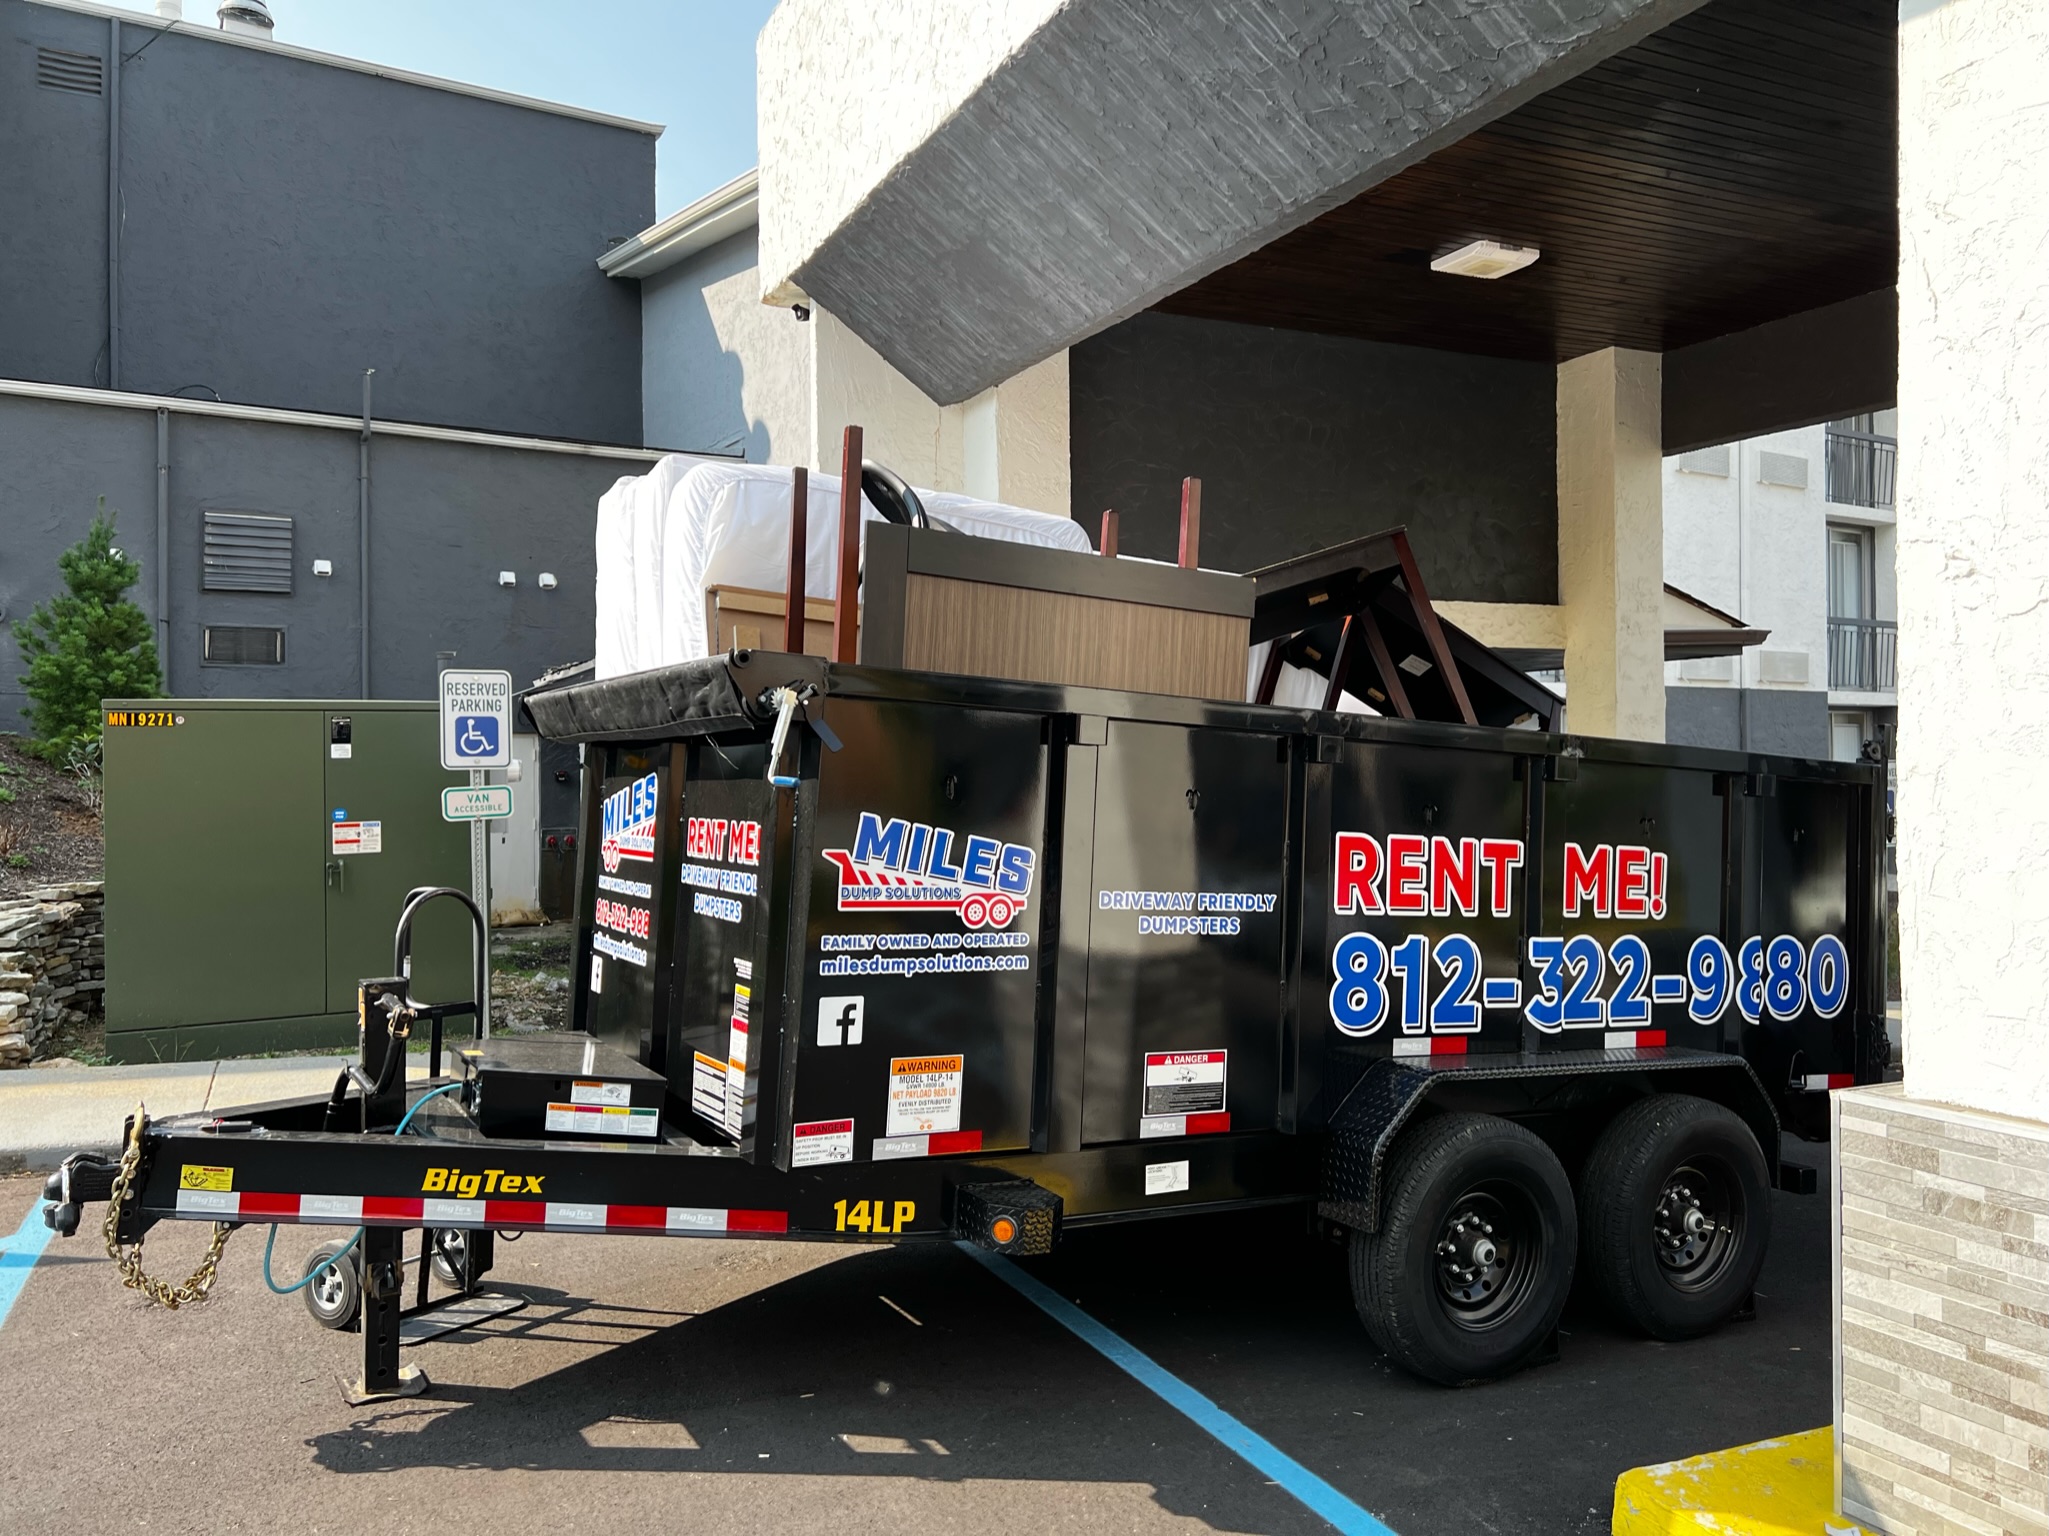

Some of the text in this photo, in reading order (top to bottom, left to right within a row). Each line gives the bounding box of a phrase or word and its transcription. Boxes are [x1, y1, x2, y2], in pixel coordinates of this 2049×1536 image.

[447, 683, 506, 696] RESERVED
[451, 699, 502, 712] PARKING
[467, 794, 489, 803] VAN
[454, 804, 503, 813] ACCESSIBLE
[603, 772, 658, 842] MILES
[687, 817, 762, 866] RENT ME!
[852, 811, 1036, 895] MILES
[681, 863, 720, 889] DRIVEWAY
[1333, 831, 1669, 921] RENT ME!
[841, 887, 961, 900] DUMP SOLUTIONS
[693, 892, 742, 923] DUMPSTERS
[1099, 891, 1277, 912] DRIVEWAY FRIENDLY
[1138, 915, 1240, 935] DUMPSTERS
[821, 932, 1029, 950] FAMILY OWNED AND OPERATED
[819, 953, 1029, 977] milesdumpsolutions.com
[1174, 1054, 1209, 1064] DANGER
[907, 1060, 956, 1071] WARNING
[899, 1073, 953, 1084] MODEL 14LP-14
[892, 1090, 904, 1100] NET
[905, 1088, 932, 1099] PAYLOAD
[898, 1098, 952, 1108] EVENLY DISTRIBUTED
[810, 1123, 846, 1133] DANGER
[1150, 1122, 1177, 1131] BigTex
[885, 1142, 917, 1152] BigTex
[421, 1167, 546, 1199] BigTex
[190, 1195, 225, 1206] BigTex
[313, 1200, 349, 1211] BigTex
[437, 1204, 472, 1214] BigTex
[558, 1208, 594, 1218] BigTex
[679, 1212, 715, 1223] BigTex
[834, 1199, 915, 1233] 14LP
